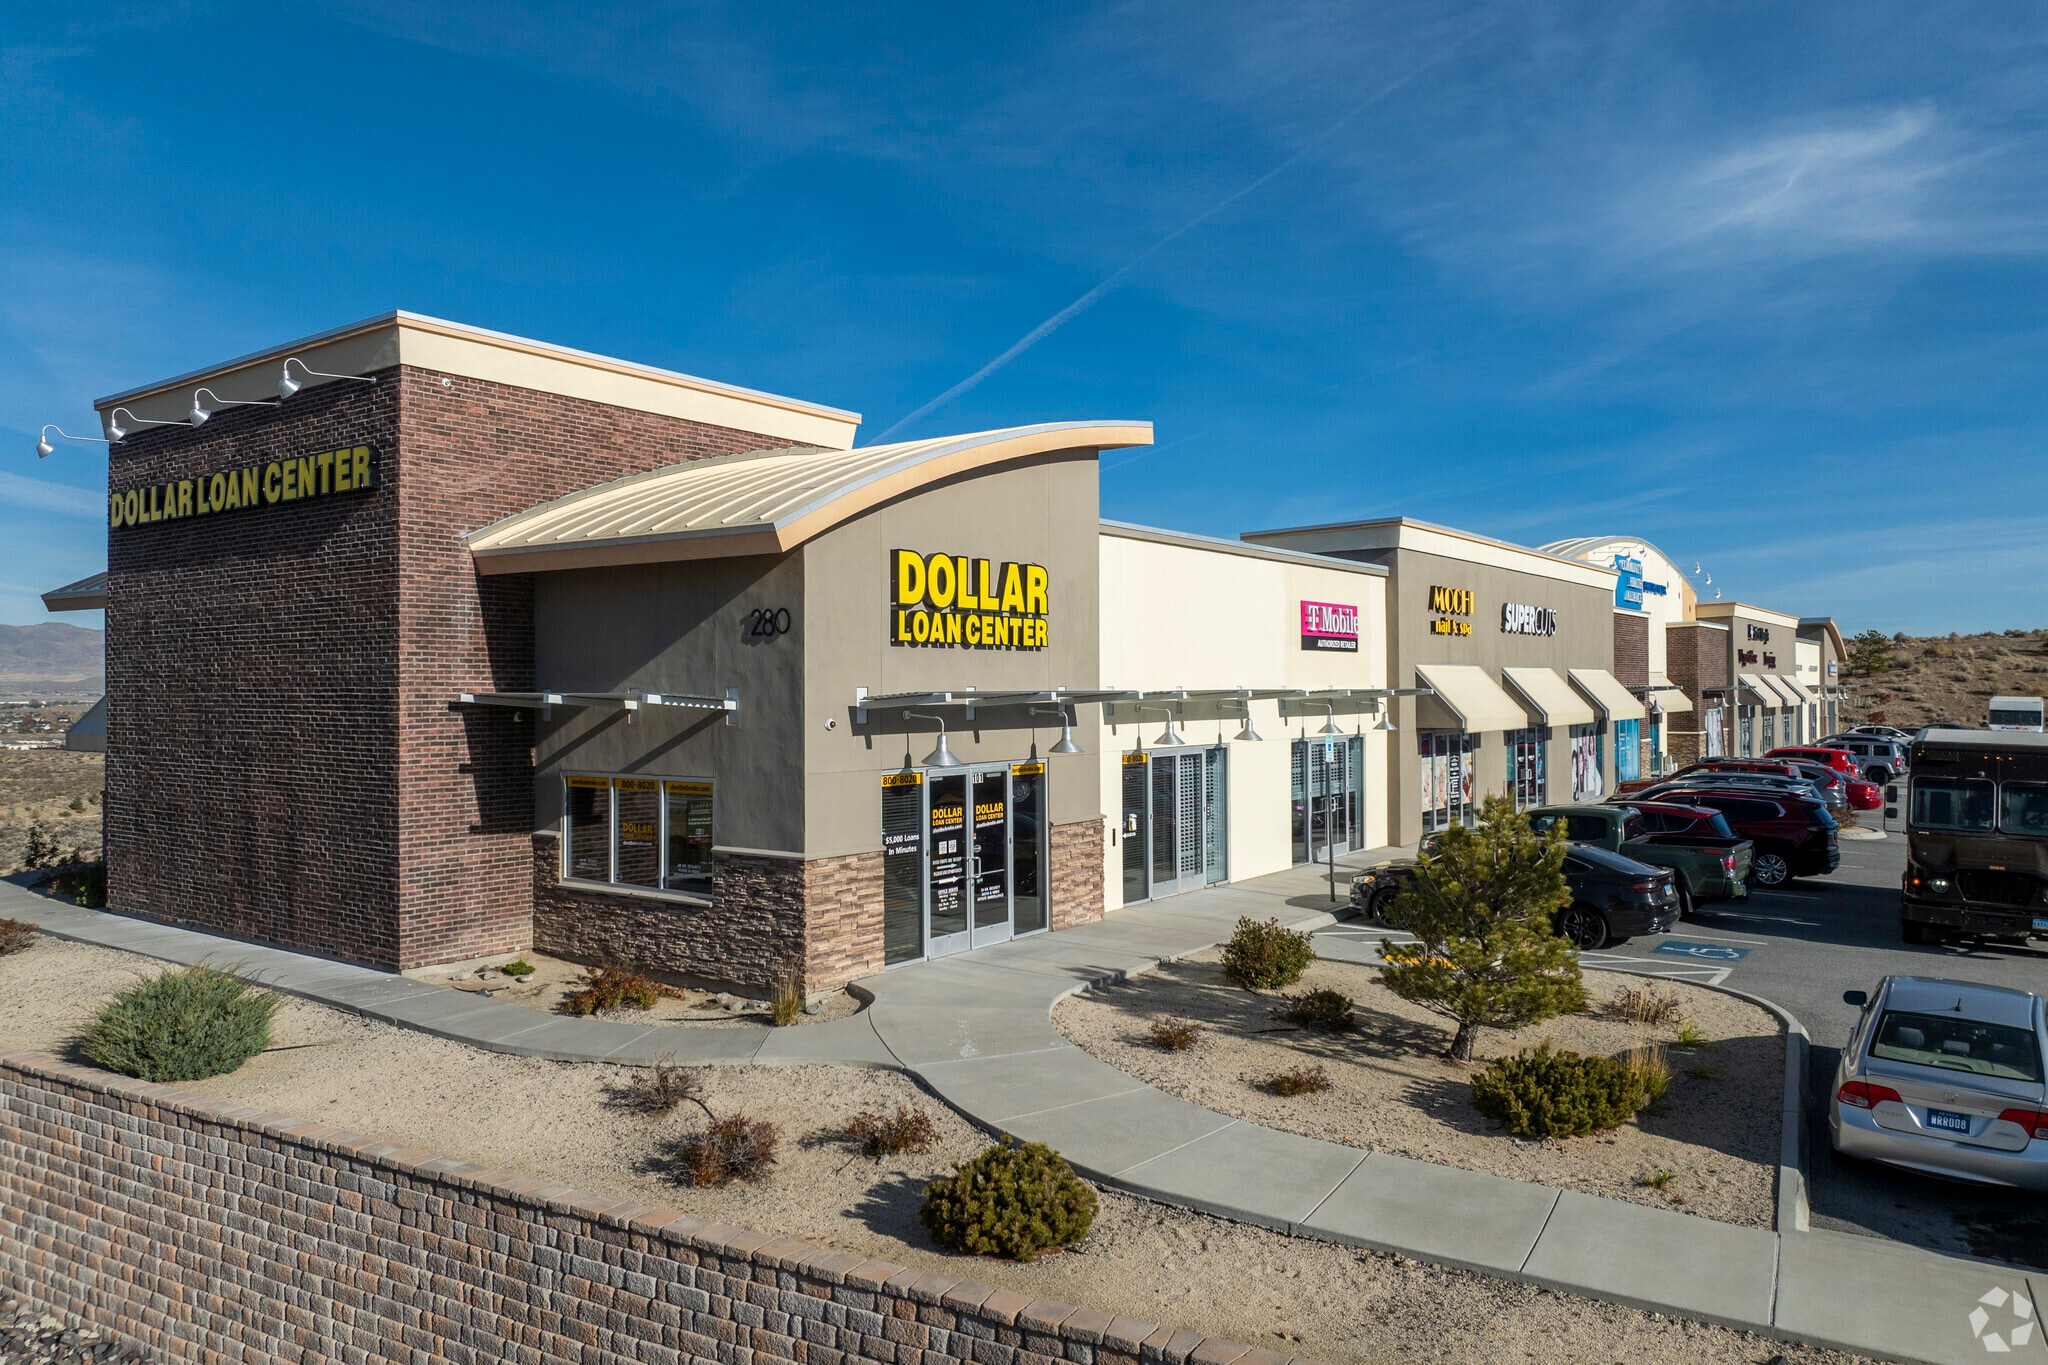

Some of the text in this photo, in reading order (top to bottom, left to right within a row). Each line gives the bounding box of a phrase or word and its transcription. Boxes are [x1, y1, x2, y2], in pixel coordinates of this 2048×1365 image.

[111, 445, 371, 528] DOLLAR LOAN CENTER
[897, 550, 1049, 615] DOLLAR
[1434, 586, 1475, 614] MOCHI
[751, 607, 791, 637] 280
[1504, 602, 1557, 636] SUPERCUTS
[897, 610, 1049, 647] LOAN CENTER
[1435, 617, 1472, 635] nail & spa
[882, 774, 917, 786] 800-8020
[972, 772, 984, 784] 101
[621, 780, 655, 790] 800-8020
[932, 807, 963, 819] DOLLAR
[975, 802, 1004, 815] DOLLAR
[622, 823, 653, 834] DOLLAR
[886, 834, 920, 845] $5,000 Loans
[895, 845, 917, 855] Minutes
